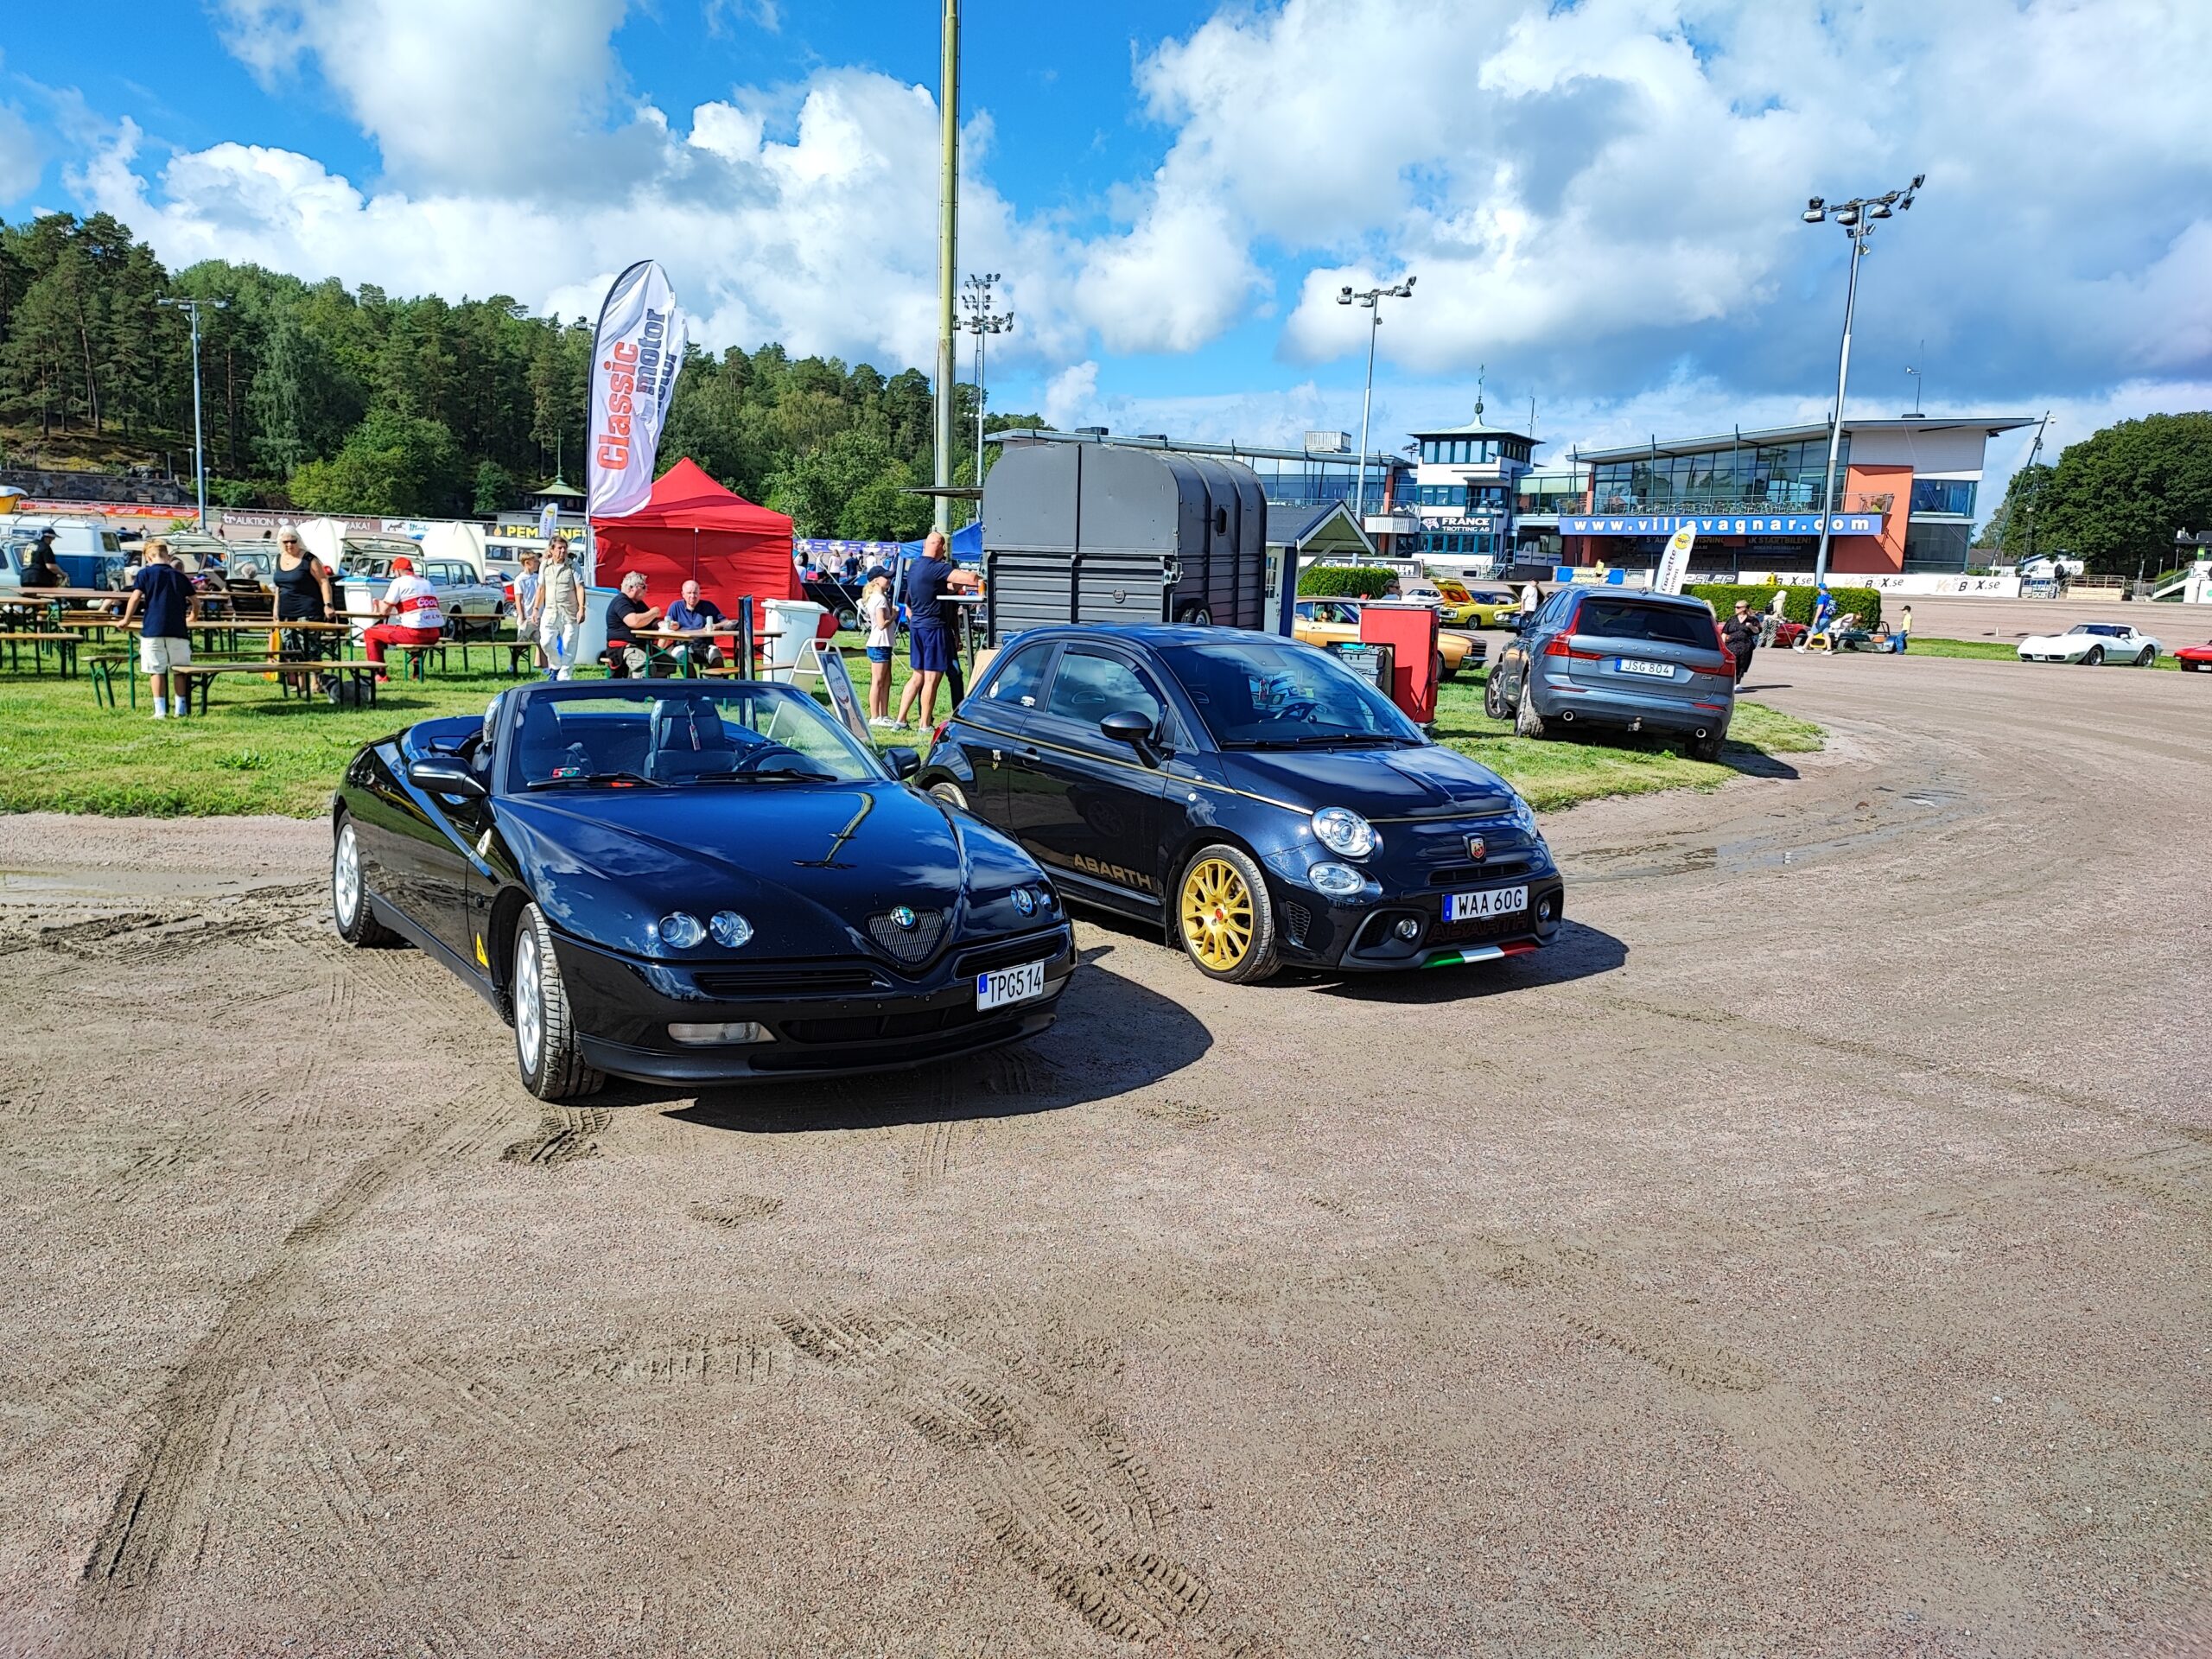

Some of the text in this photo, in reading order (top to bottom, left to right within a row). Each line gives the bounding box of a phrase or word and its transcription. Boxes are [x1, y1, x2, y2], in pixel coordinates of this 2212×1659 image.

[636, 308, 665, 396] motor
[597, 341, 639, 471] Classic
[236, 516, 275, 526] AUKTION
[507, 525, 538, 538] PEM
[1441, 517, 1490, 526] FRANCE
[1625, 661, 1669, 674] JSG 804
[1074, 853, 1153, 890] ABARTH
[1458, 888, 1522, 917] WAA 60G
[988, 965, 1041, 1003] TPG514
